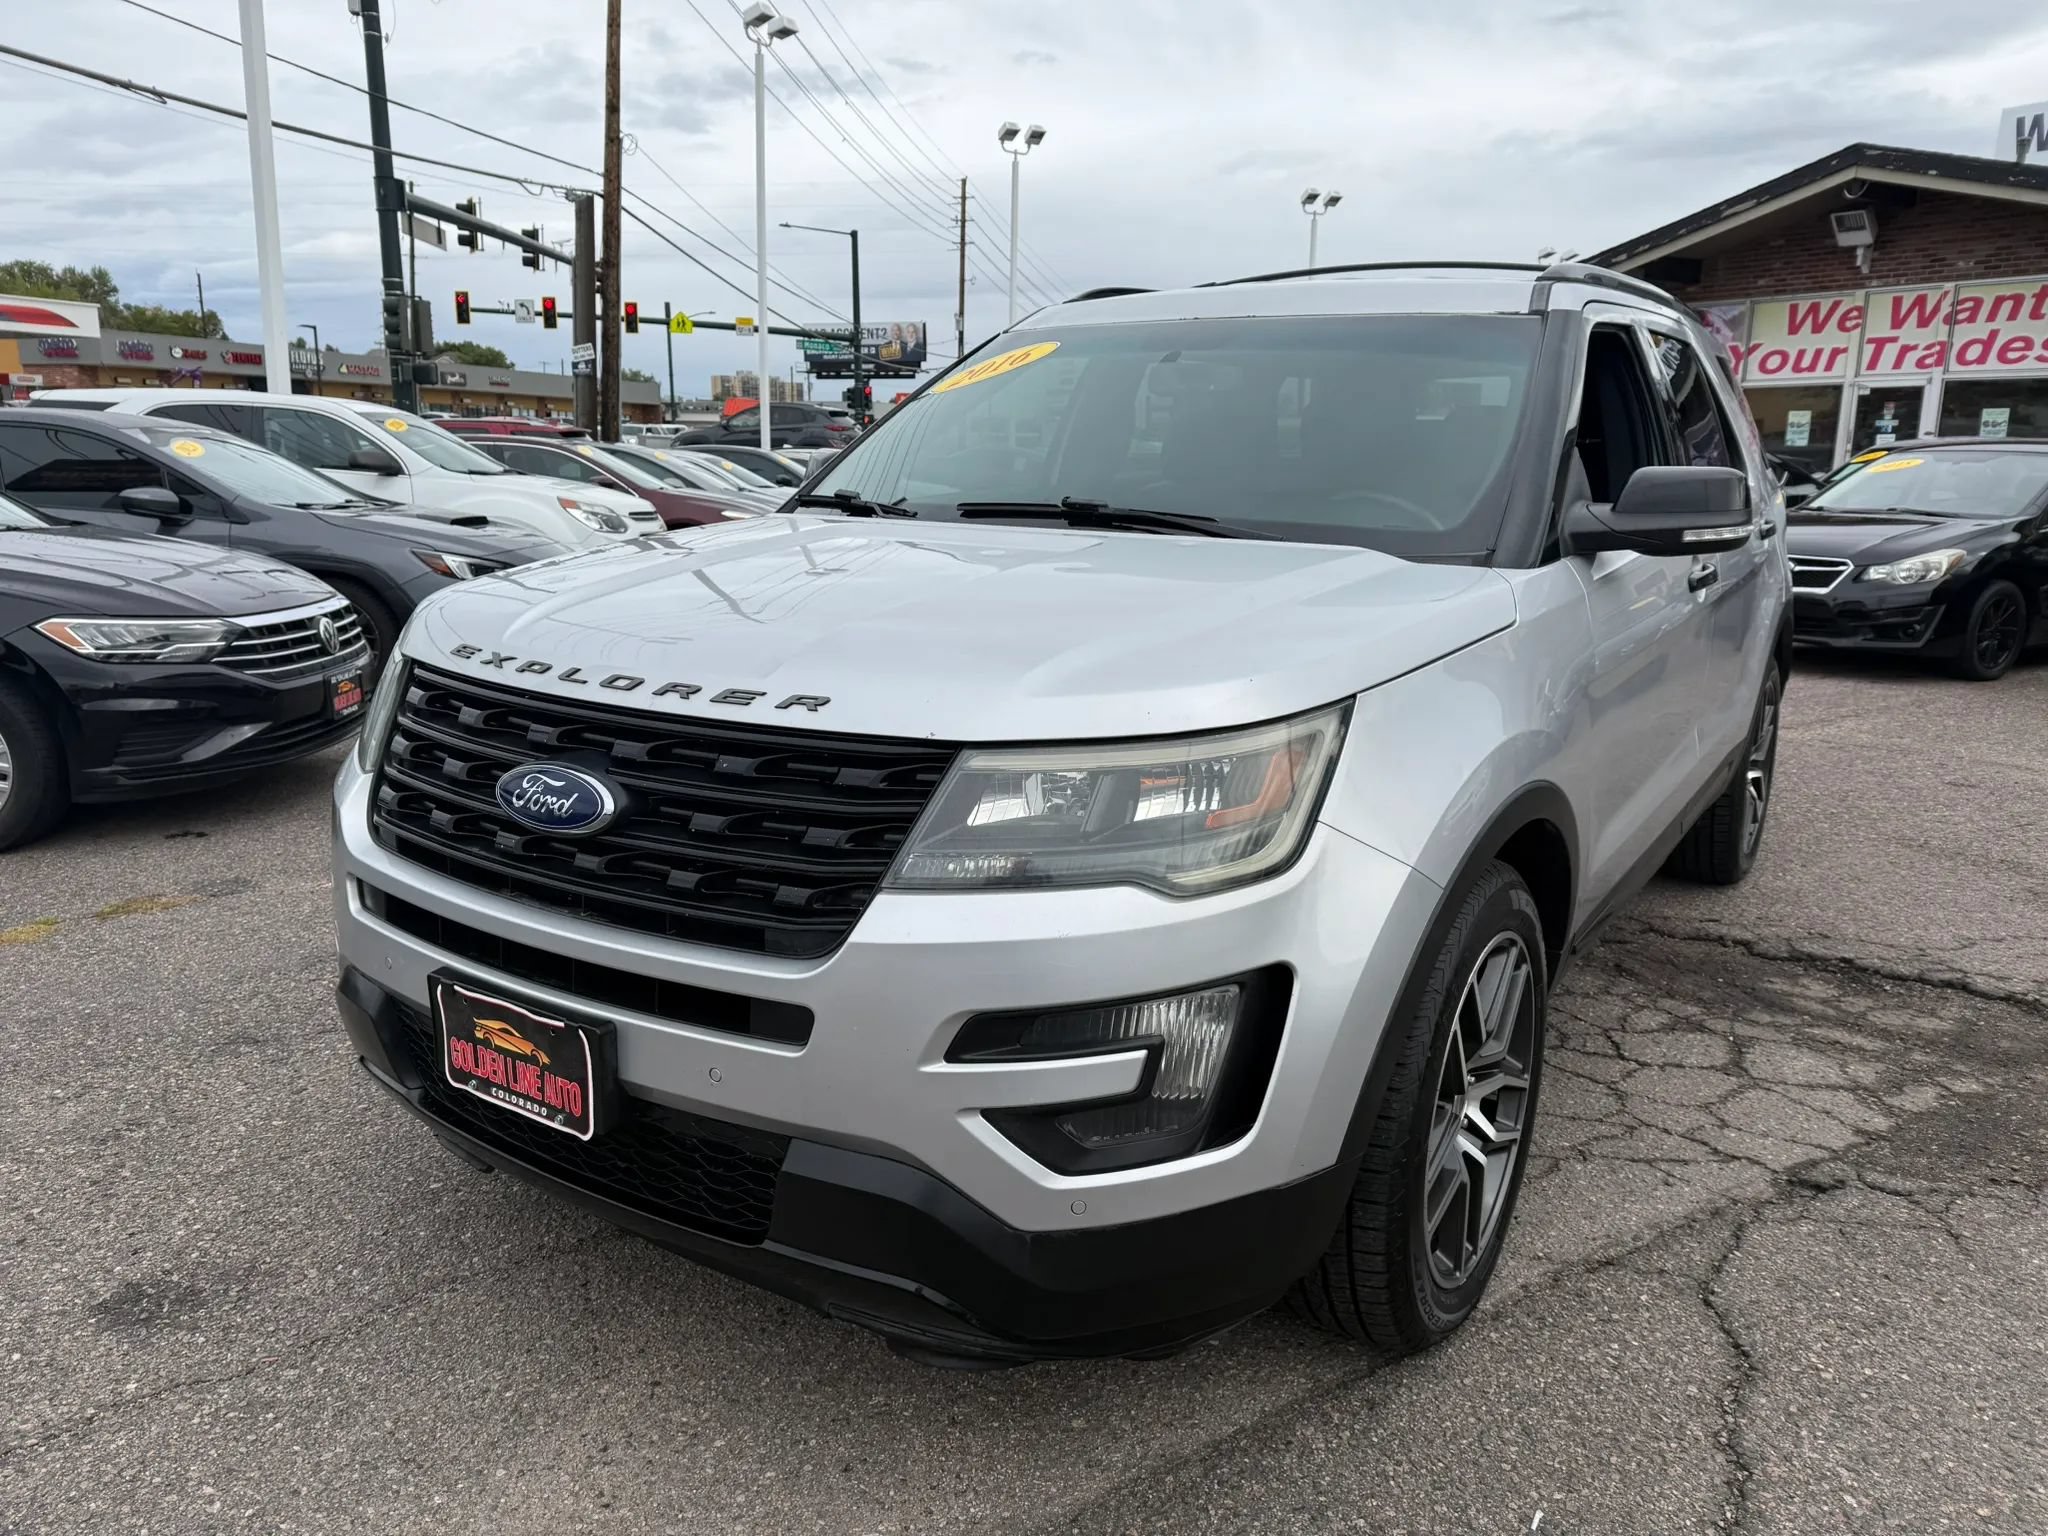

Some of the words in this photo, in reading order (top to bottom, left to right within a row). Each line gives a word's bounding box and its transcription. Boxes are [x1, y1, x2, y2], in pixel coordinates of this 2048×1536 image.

[1787, 299, 1864, 336] We
[1889, 284, 2048, 328] Want
[803, 341, 831, 350] Monaco
[944, 344, 1046, 389] 2016
[1727, 342, 1850, 376] Your
[449, 643, 831, 712] EXPLORER
[512, 773, 579, 819] Ford
[450, 1035, 506, 1087] GOLDEN
[506, 1056, 543, 1102] LINE
[544, 1070, 583, 1117] AUTO
[491, 1087, 548, 1116] COLORADO
